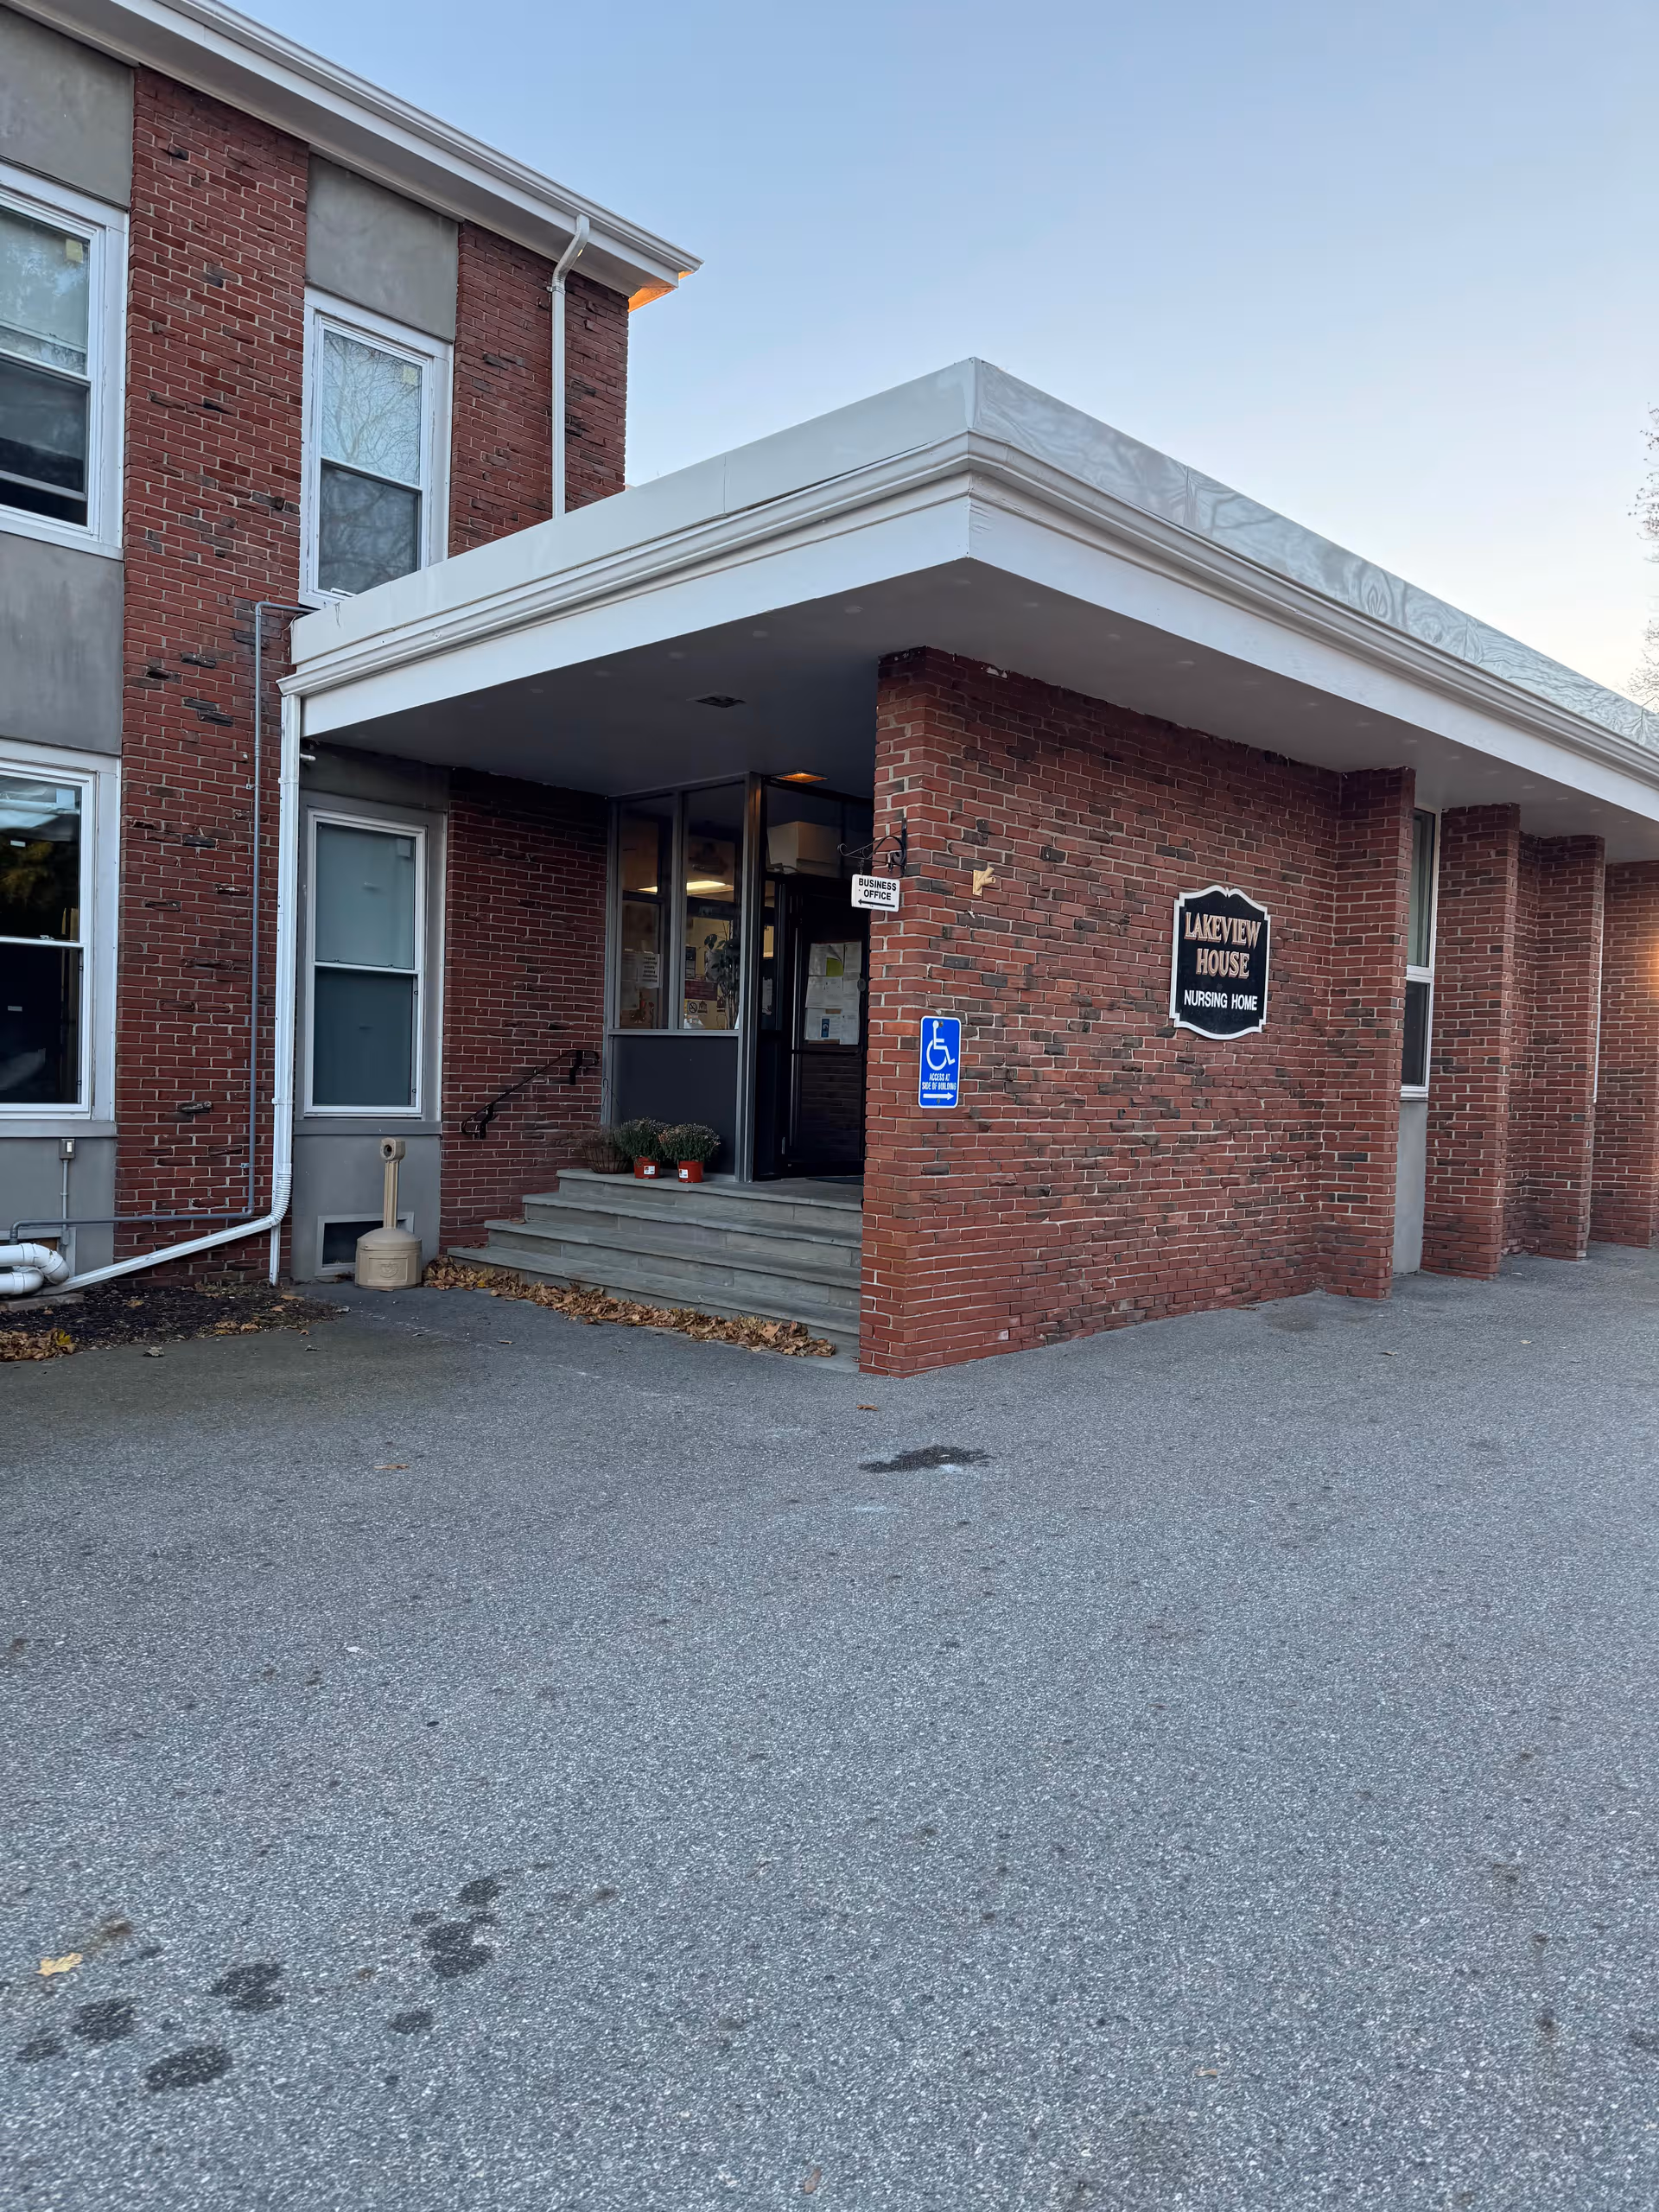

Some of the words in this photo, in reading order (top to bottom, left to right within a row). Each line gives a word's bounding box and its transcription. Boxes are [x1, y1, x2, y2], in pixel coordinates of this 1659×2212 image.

[859, 878, 896, 891] BUSINESS
[864, 889, 891, 900] OFFICE
[1184, 912, 1262, 949] LAKEVIEW
[1196, 948, 1250, 979] HOUSE
[1184, 989, 1228, 1009] NURSING
[1231, 994, 1258, 1011] HOME
[929, 1072, 944, 1081] ACCESS
